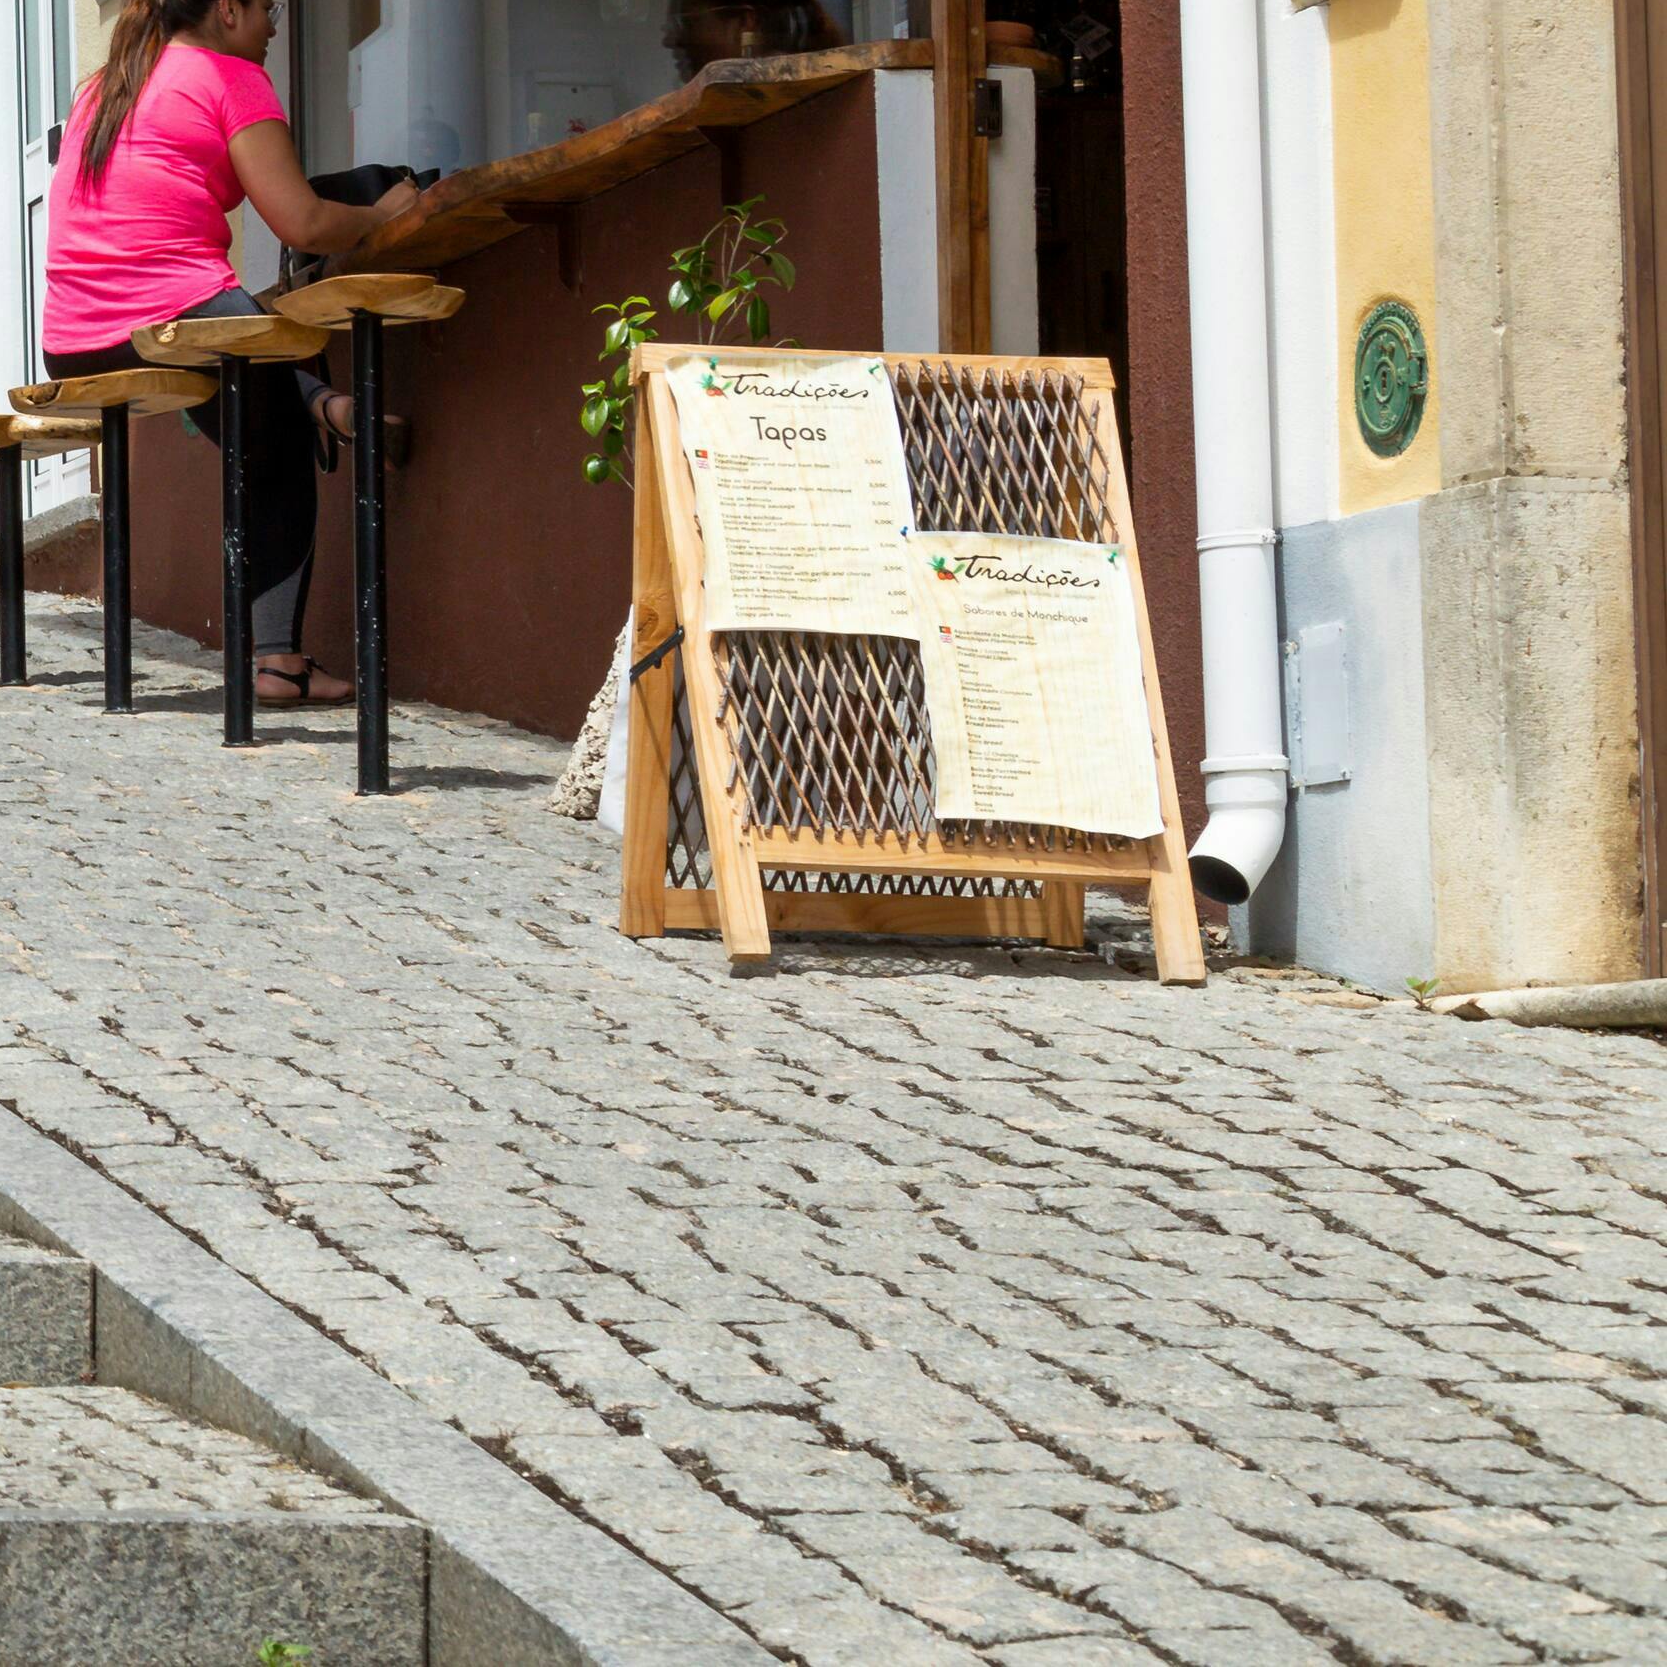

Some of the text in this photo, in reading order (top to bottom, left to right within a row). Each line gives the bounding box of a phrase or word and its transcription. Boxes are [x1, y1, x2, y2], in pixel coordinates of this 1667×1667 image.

[721, 373, 869, 402] Tradições
[749, 416, 827, 450] Tapas
[954, 555, 1100, 588] Tradições
[963, 603, 1089, 628] Sabores de Monchique
